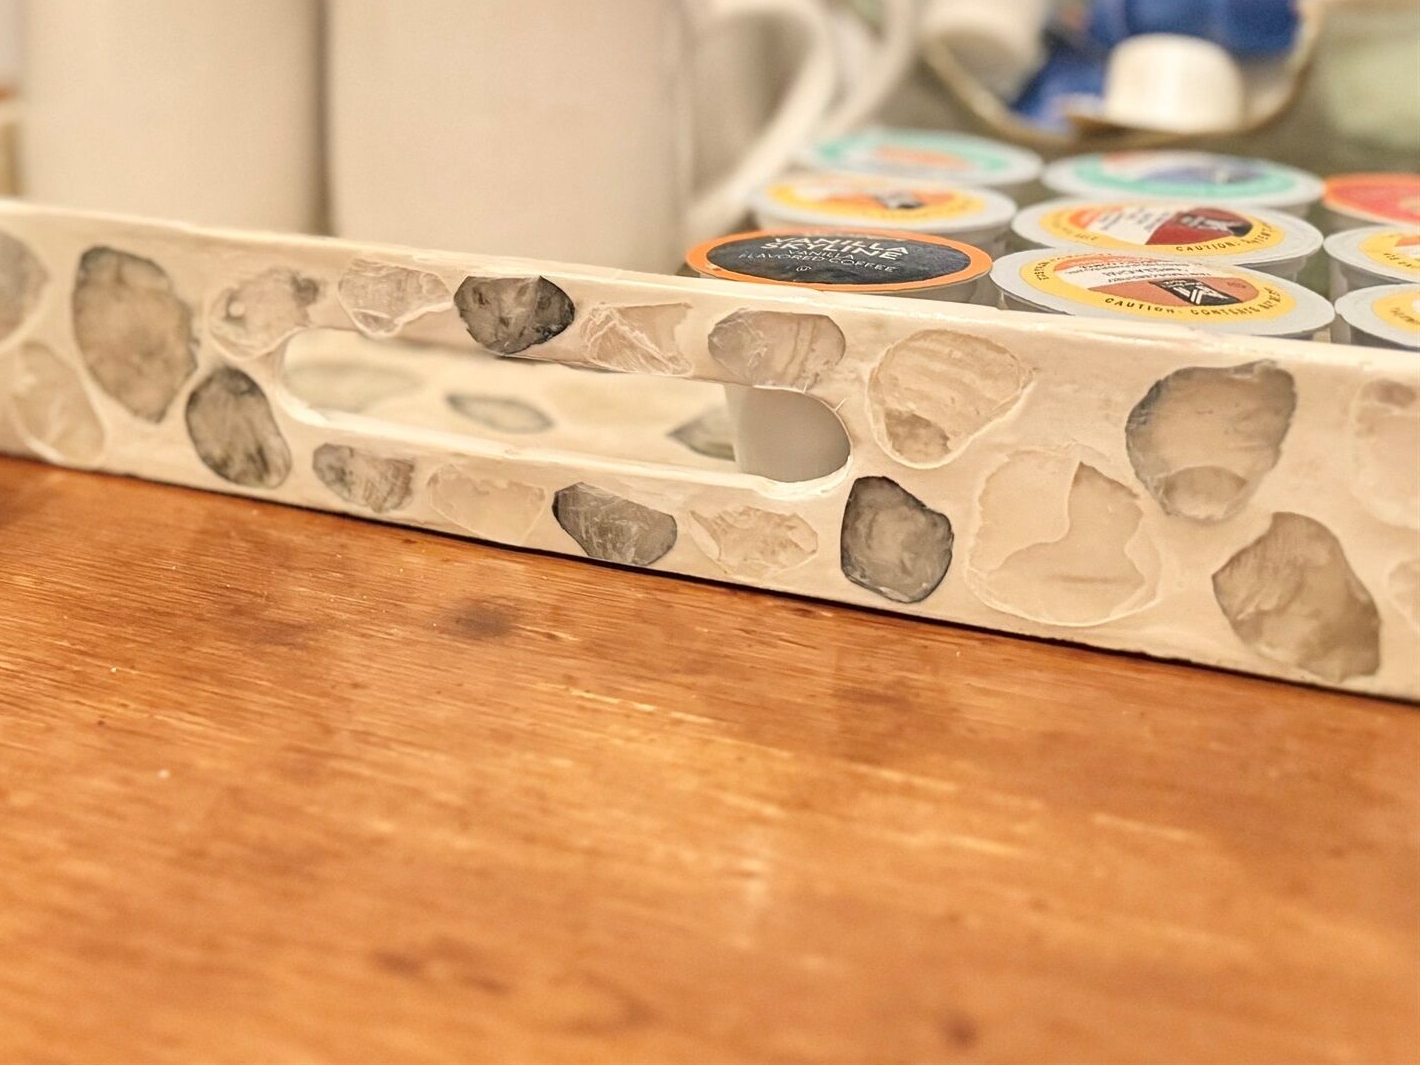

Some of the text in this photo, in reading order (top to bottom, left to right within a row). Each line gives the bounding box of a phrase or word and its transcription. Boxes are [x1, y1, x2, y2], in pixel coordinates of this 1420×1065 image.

[760, 242, 903, 260] SKYLINE
[774, 237, 909, 255] VANILLA
[787, 249, 855, 260] VANILLA
